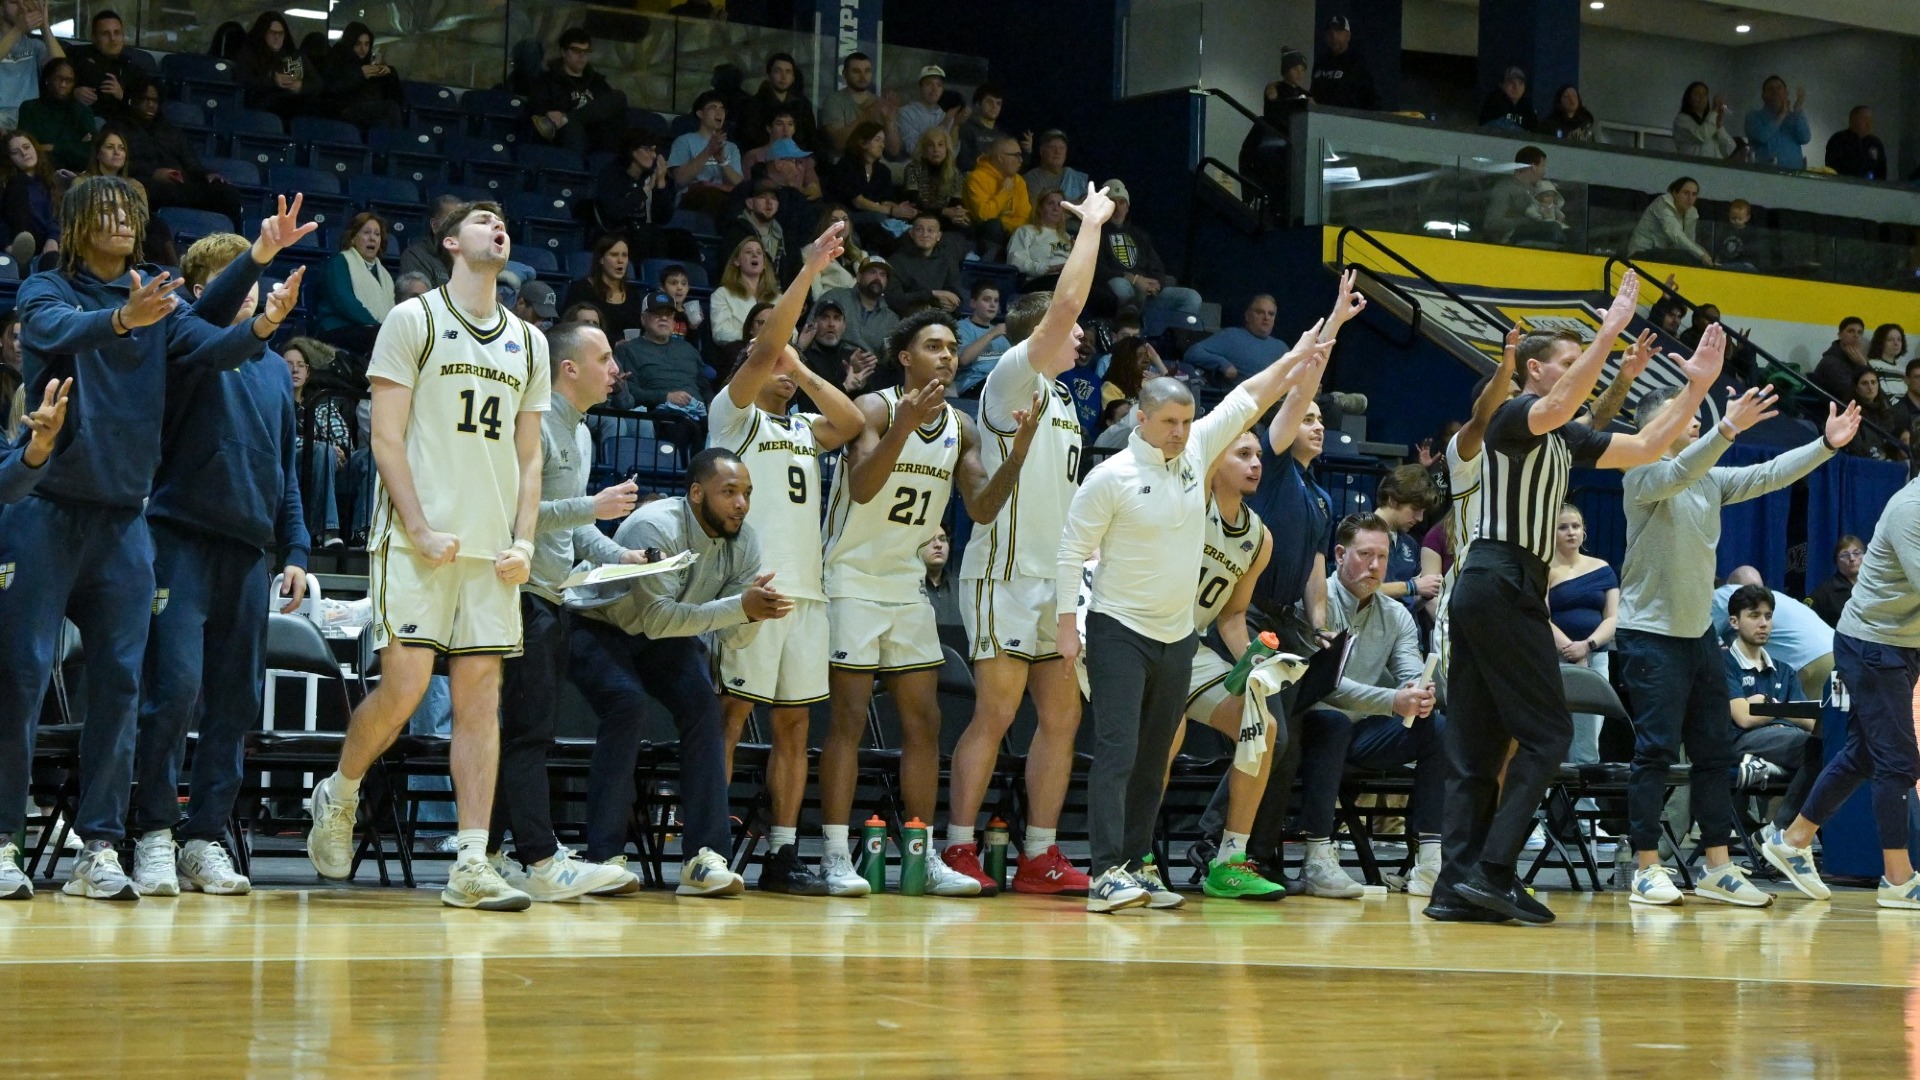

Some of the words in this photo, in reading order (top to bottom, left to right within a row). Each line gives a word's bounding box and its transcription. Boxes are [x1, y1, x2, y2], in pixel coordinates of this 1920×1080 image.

[440, 363, 521, 392] MERRIMACK
[457, 389, 502, 440] 14
[1066, 444, 1079, 482] 0
[788, 465, 807, 504] 9
[887, 486, 932, 526] 21
[867, 837, 882, 854] G
[557, 869, 578, 886] N
[690, 863, 712, 883] N
[1044, 869, 1064, 881] N
[1226, 877, 1242, 888] N
[1716, 874, 1745, 894] N
